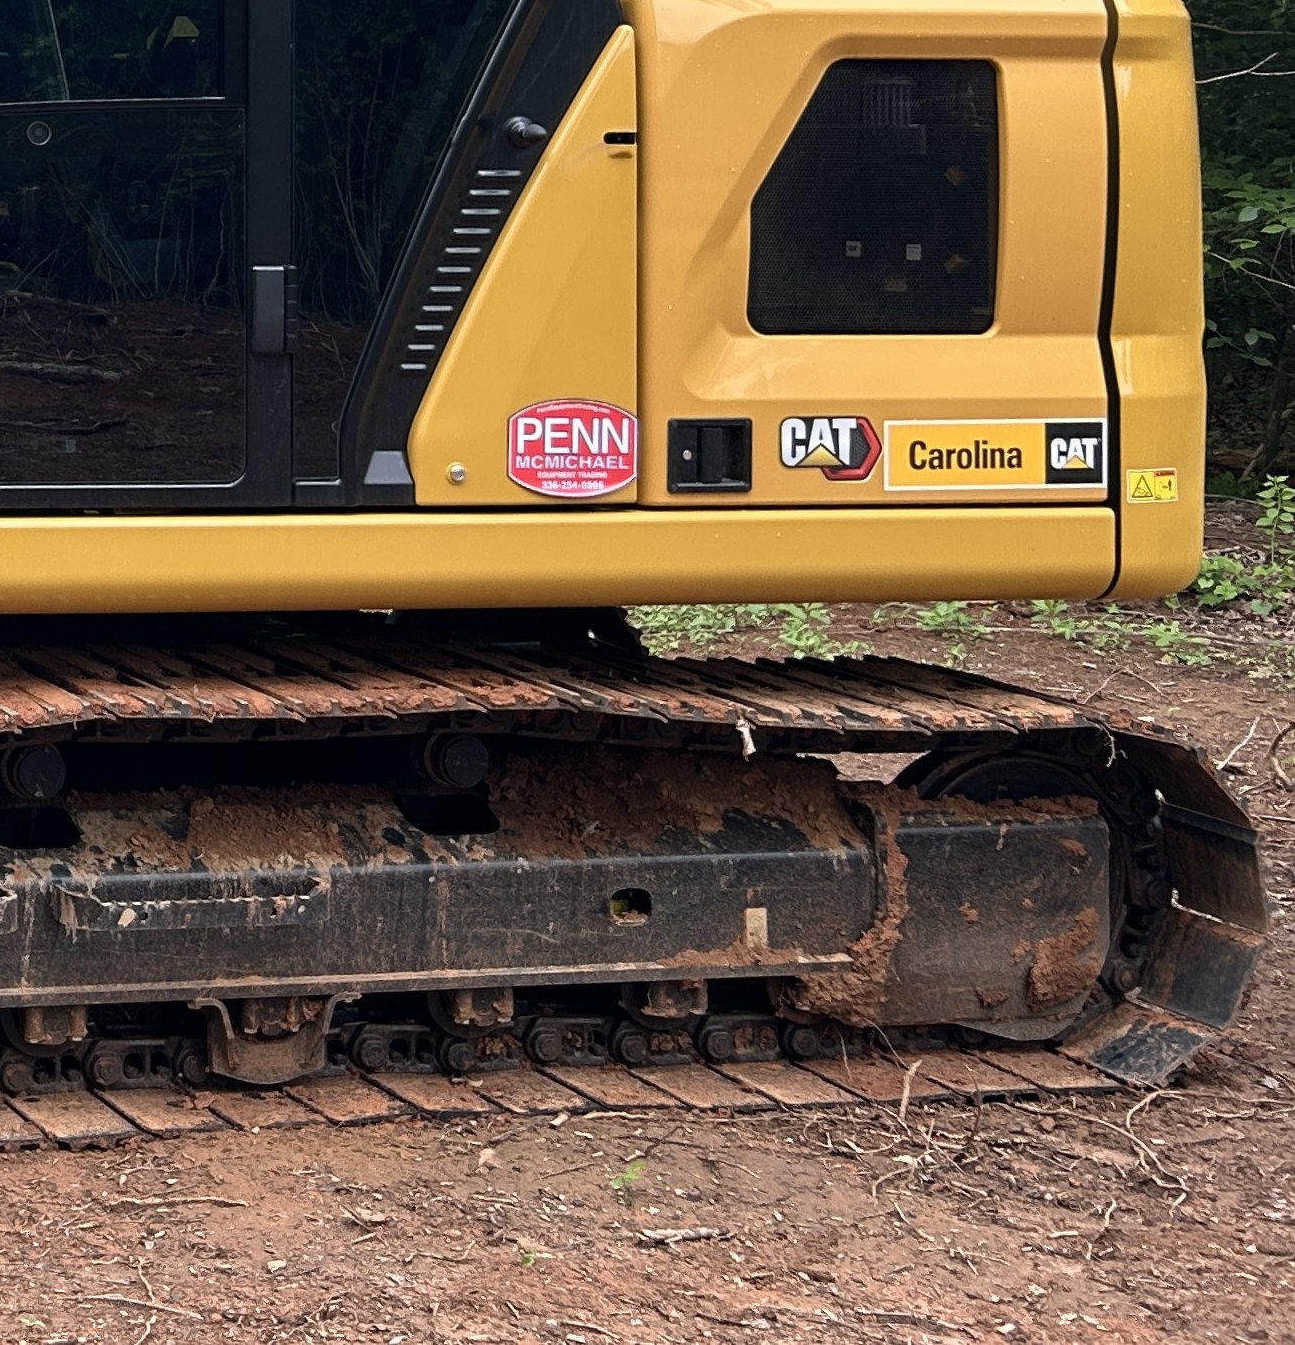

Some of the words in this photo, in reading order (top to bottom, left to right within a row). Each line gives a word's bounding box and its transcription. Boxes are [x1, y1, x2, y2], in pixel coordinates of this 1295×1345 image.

[516, 417, 629, 454] PENN
[780, 417, 857, 467] CAT
[515, 455, 629, 469] MCMICHAEL
[910, 440, 1023, 471] Carolina
[1050, 437, 1099, 469] CAT
